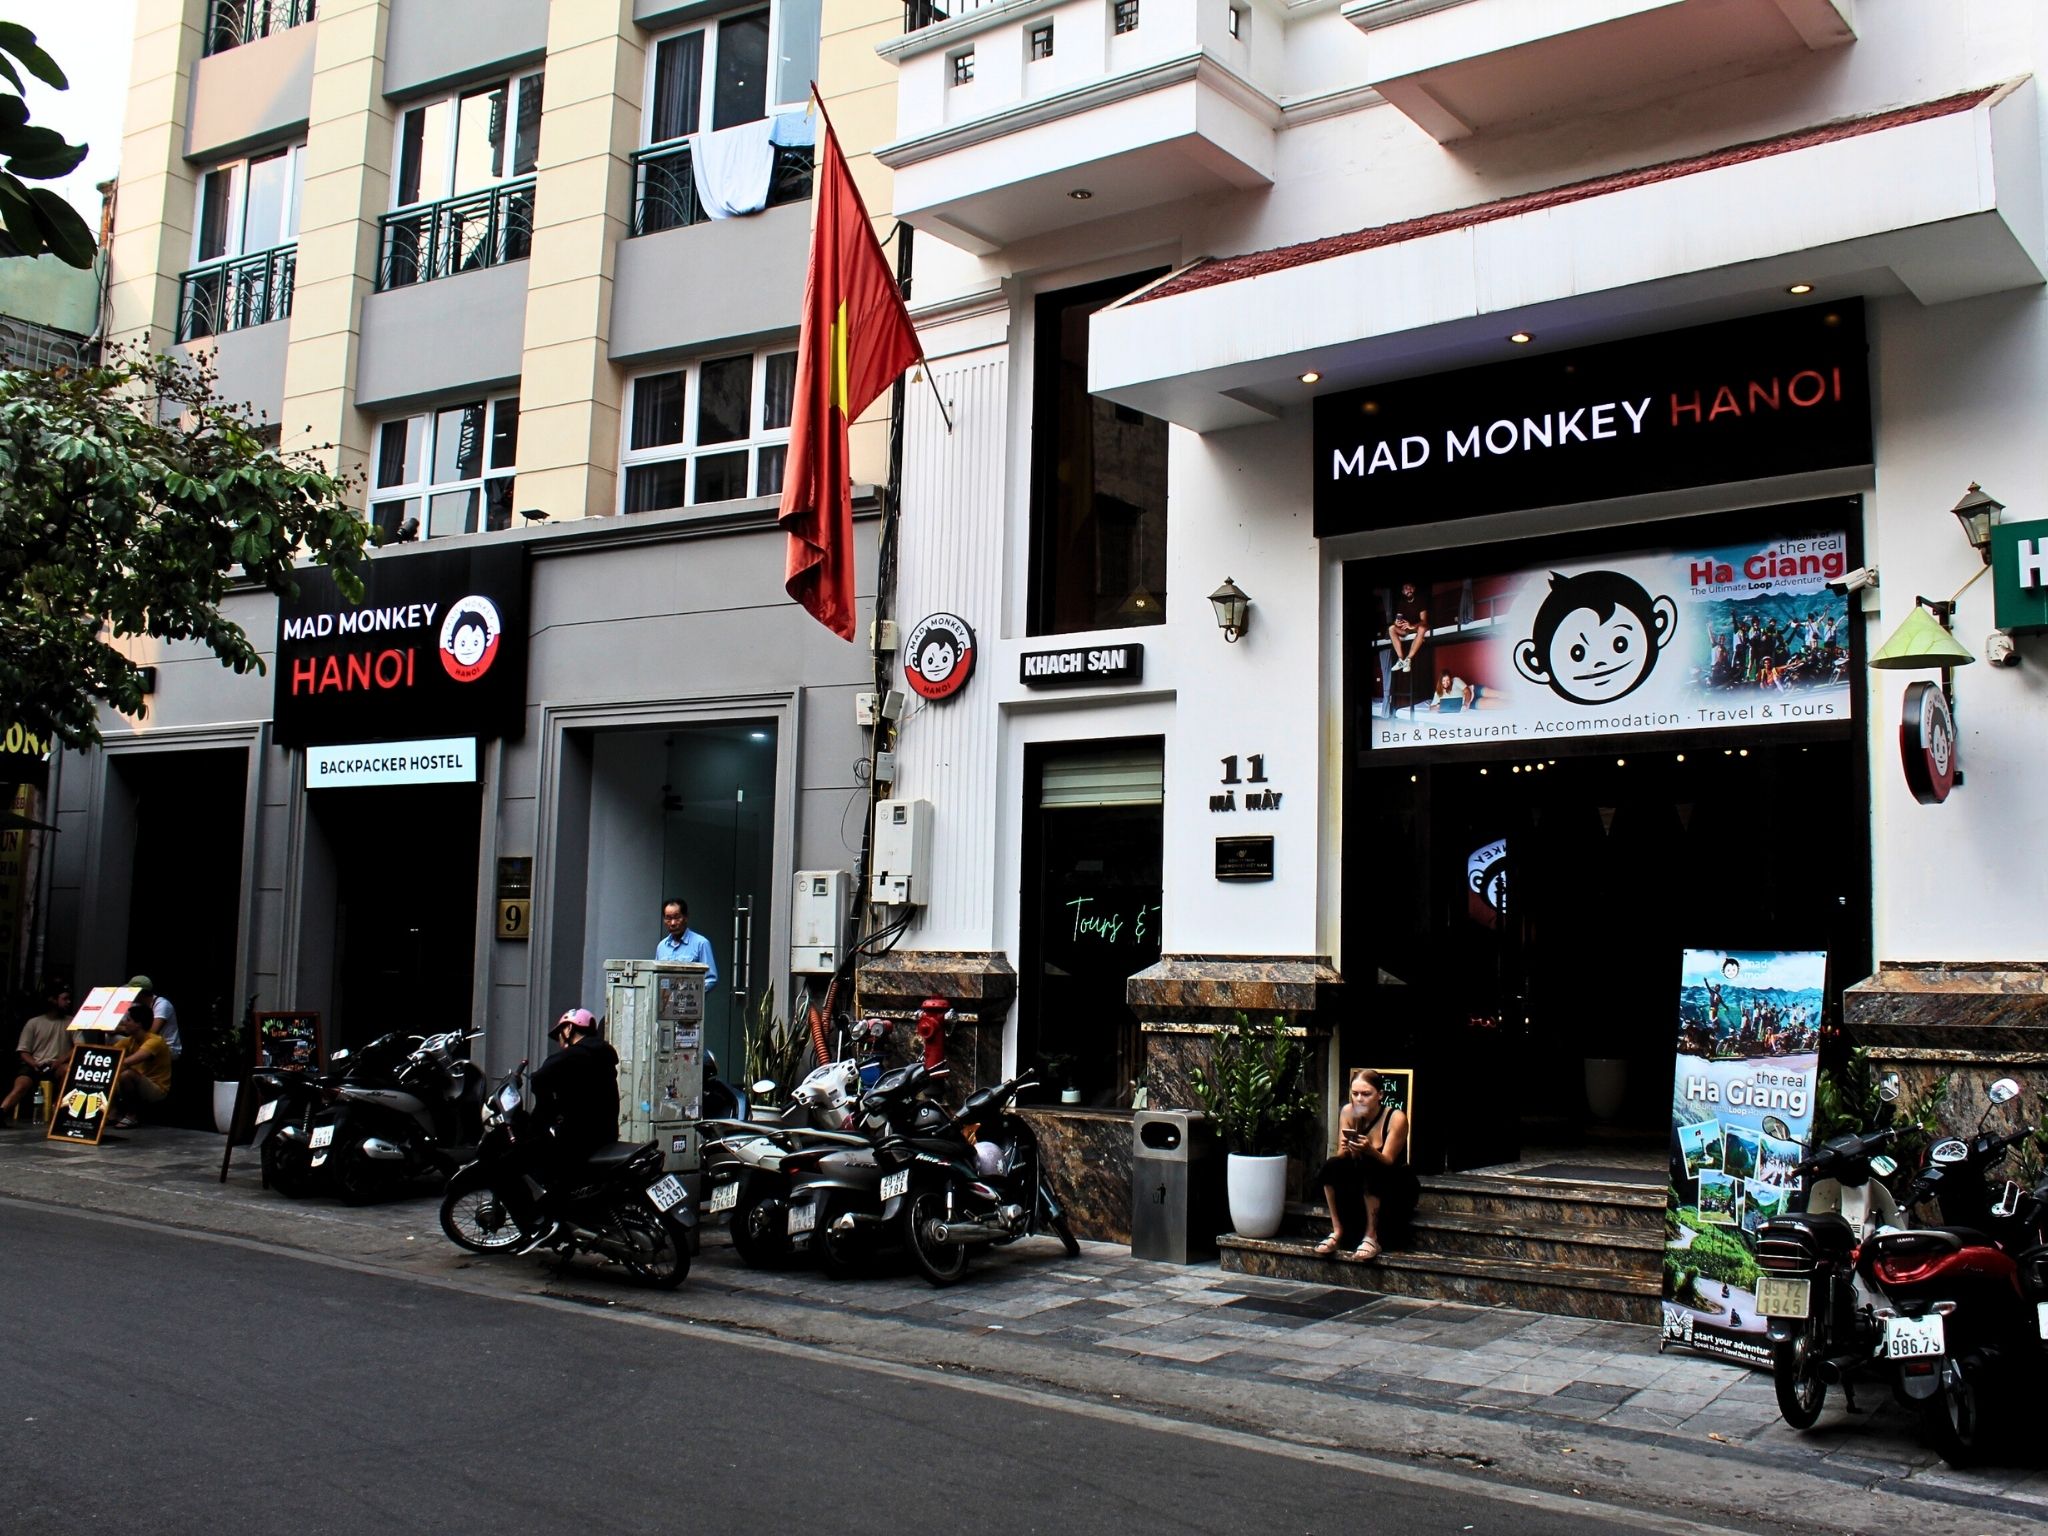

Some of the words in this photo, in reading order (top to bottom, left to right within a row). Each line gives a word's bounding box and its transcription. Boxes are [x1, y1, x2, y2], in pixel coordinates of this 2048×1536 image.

[1333, 434, 1430, 480] MAD
[1446, 397, 1652, 464] MONKEY
[1670, 367, 1841, 427] HANOI
[1779, 541, 1806, 555] the
[1812, 535, 1841, 551] real
[1690, 560, 1733, 587] Ha
[1743, 550, 1844, 580] Giang
[1690, 587, 1706, 596] The
[1708, 582, 1747, 594] Ultimate
[1748, 581, 1773, 593] Loop
[1774, 576, 1823, 588] Adventure
[283, 613, 333, 641] MAD
[338, 602, 438, 635] MONKEY
[910, 627, 925, 650] MAD
[930, 617, 965, 637] MONKEY
[292, 647, 415, 696] HANOI
[455, 667, 481, 678] HANOI
[1024, 652, 1083, 677] KHACH
[1086, 648, 1127, 675] SẠN
[923, 683, 952, 695] HANOI
[1382, 729, 1408, 744] Bar
[1412, 727, 1424, 742] &
[1428, 722, 1519, 741] Restaurant
[1533, 711, 1681, 734] Accommodation
[1697, 704, 1756, 723] Travel
[1761, 703, 1774, 718] &
[1780, 701, 1836, 718] Tours
[320, 756, 407, 775] BACKPACKER
[410, 754, 463, 771] HOSTEL
[1220, 753, 1269, 785] 11
[505, 904, 522, 932] 9
[1065, 896, 1124, 943] Tours
[83, 1050, 112, 1068] free
[74, 1065, 113, 1084] beer!
[1756, 1071, 1779, 1086] the
[1782, 1074, 1807, 1088] real
[1686, 1076, 1720, 1102] Ha
[1726, 1078, 1808, 1118] Giang
[1728, 1105, 1747, 1116] Loop
[1762, 1298, 1801, 1315] 1945
[1693, 1331, 1714, 1343] start
[1714, 1335, 1733, 1347] your
[1733, 1340, 1772, 1357] adventur
